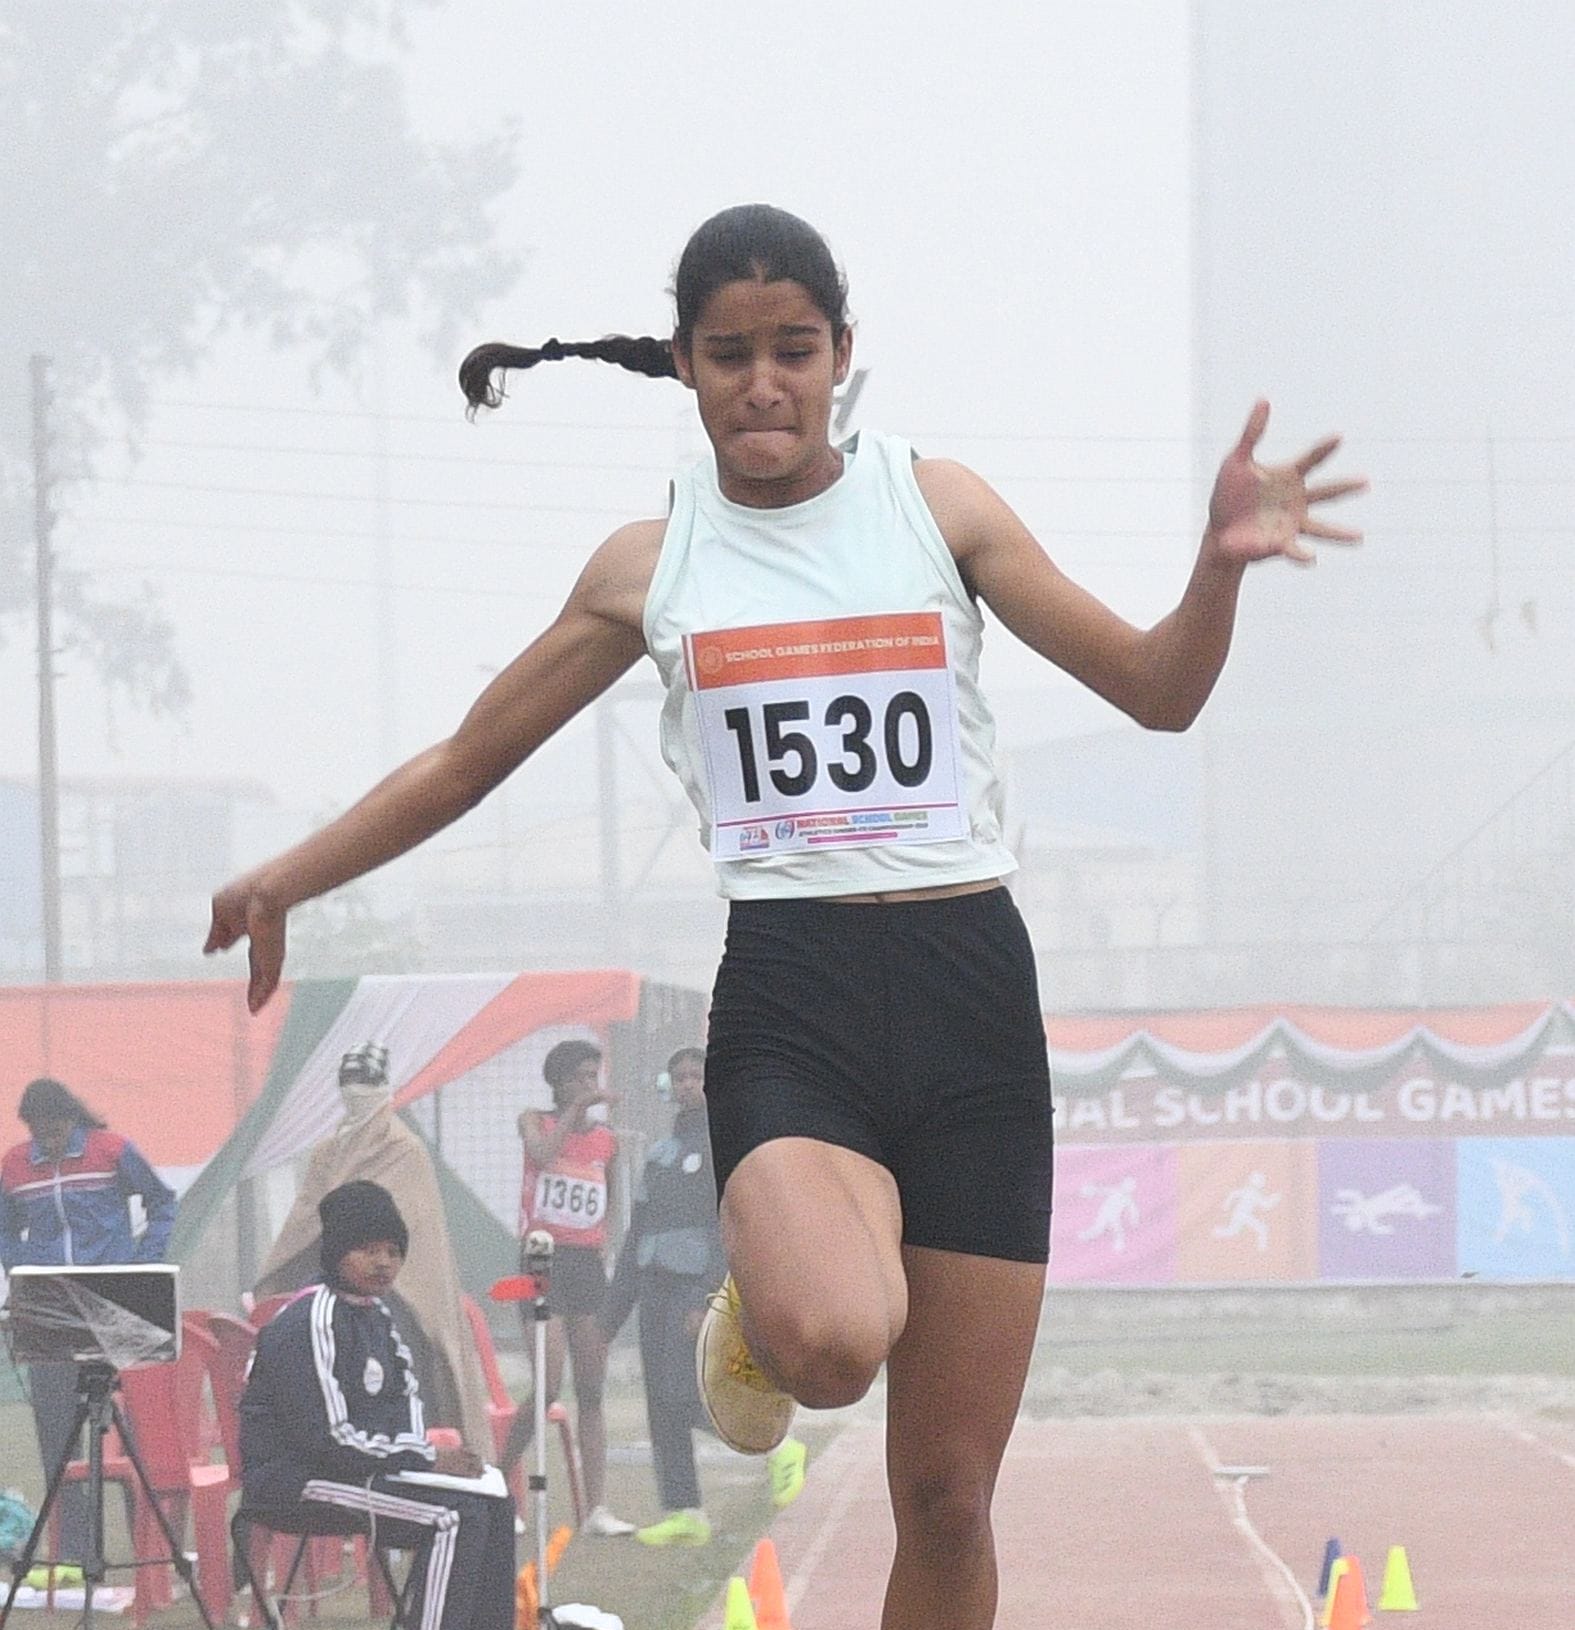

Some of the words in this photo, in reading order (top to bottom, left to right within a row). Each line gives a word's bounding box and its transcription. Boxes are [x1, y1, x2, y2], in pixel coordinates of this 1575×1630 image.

[726, 648, 774, 663] SCHOOL
[776, 643, 819, 657] GAMES
[820, 638, 893, 654] FEDERATION
[895, 637, 911, 648] OF
[724, 690, 933, 803] 1530
[1153, 1079, 1385, 1128] SCHOOL
[542, 1177, 600, 1217] 1366
